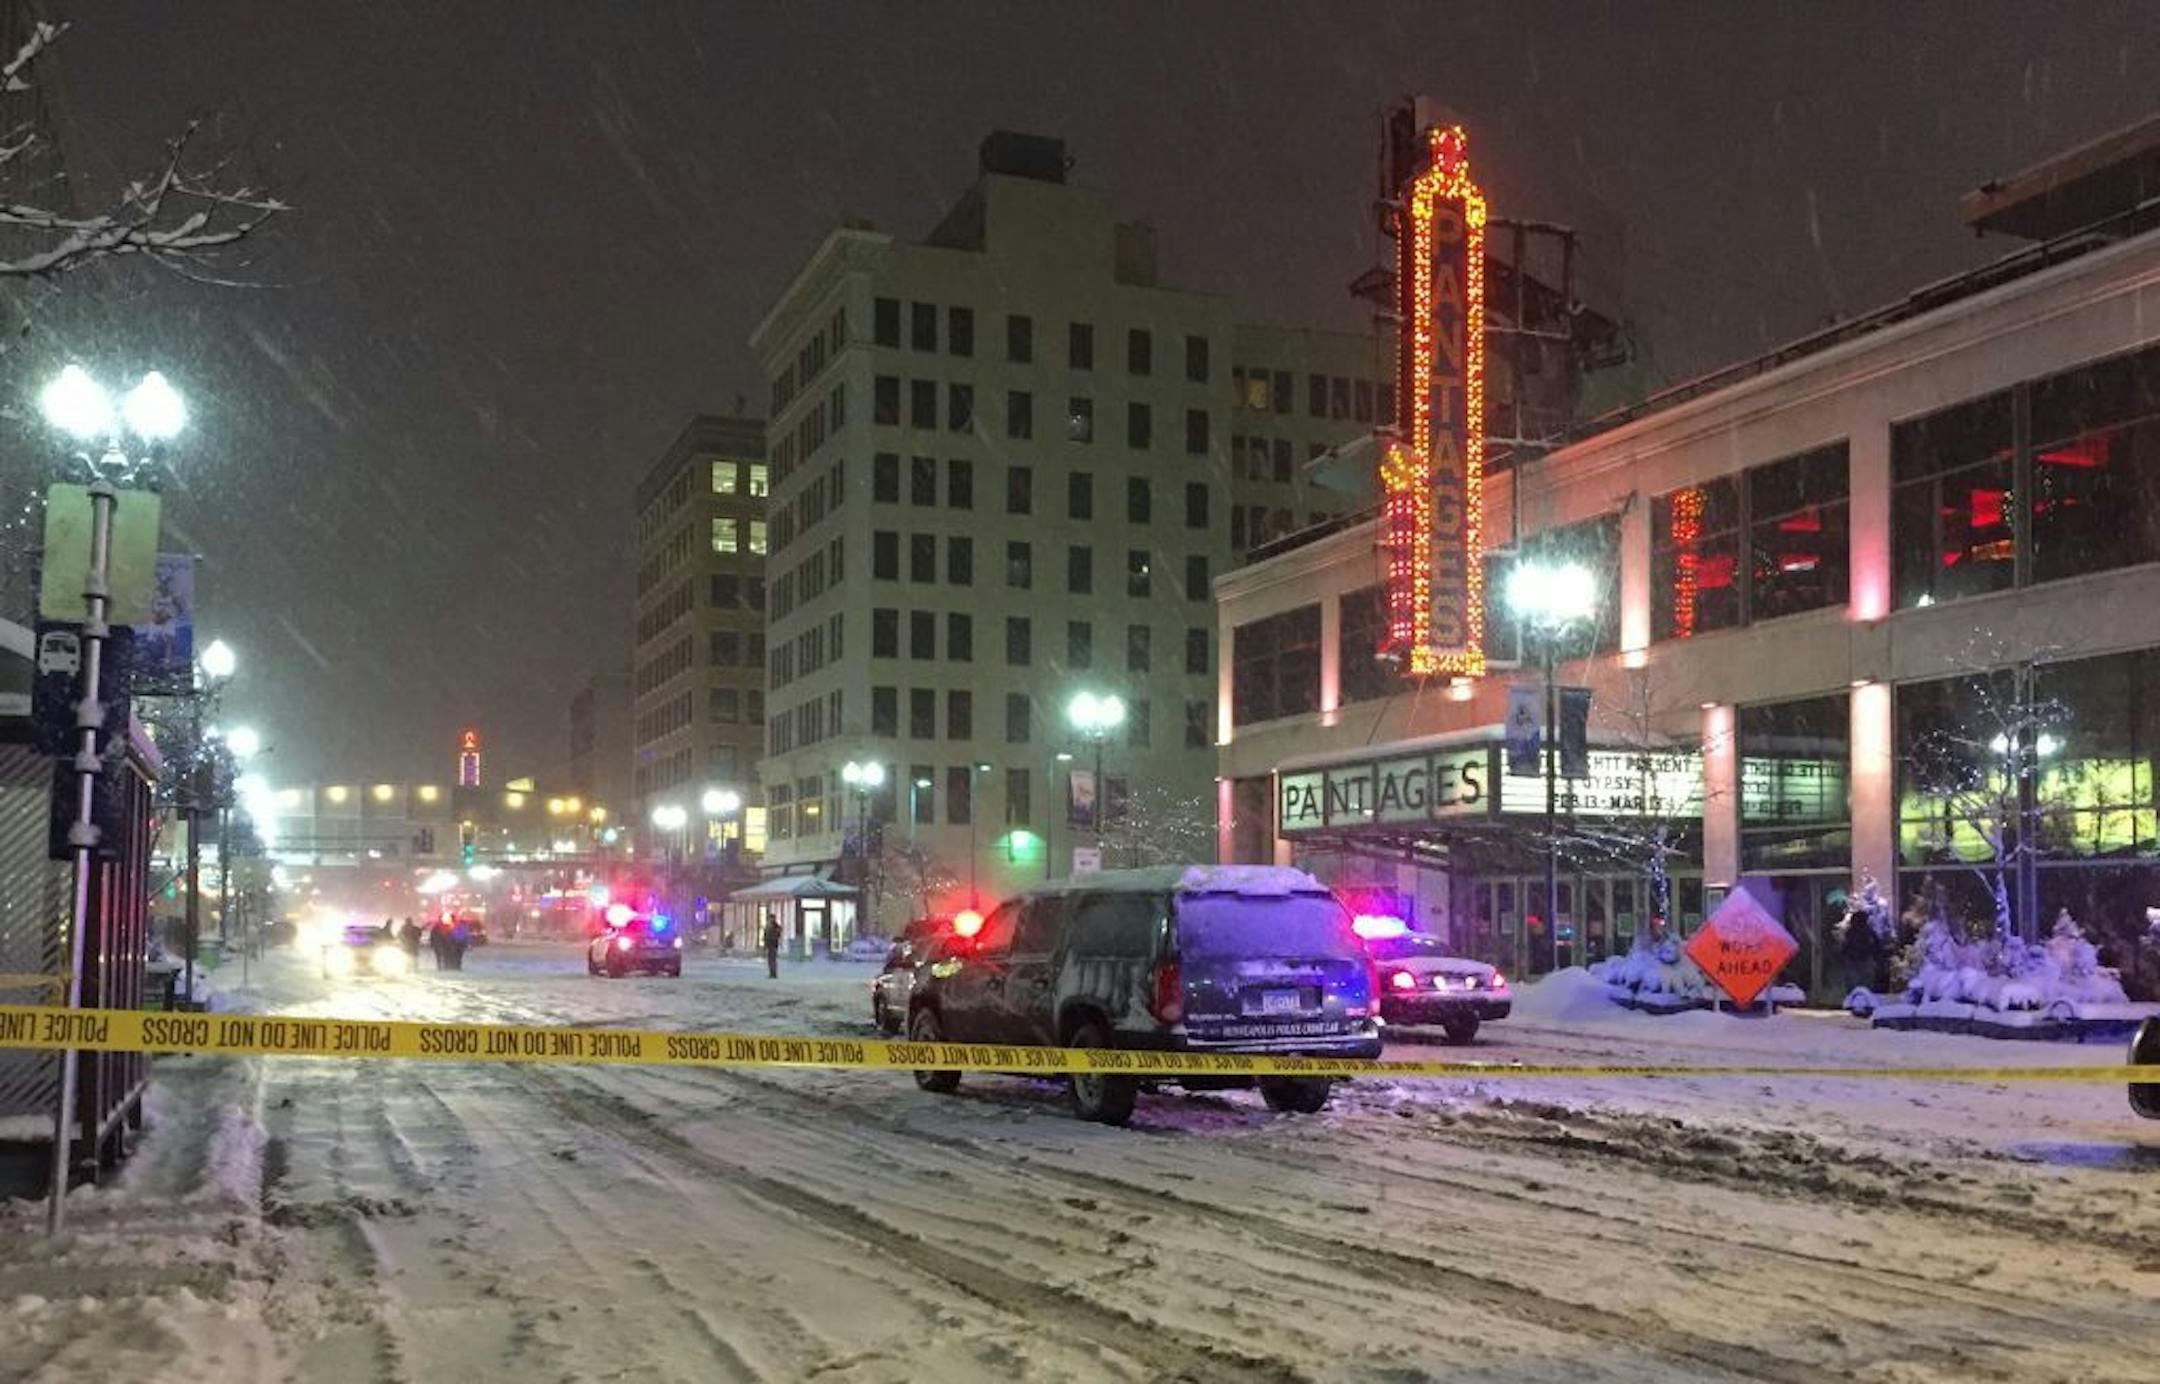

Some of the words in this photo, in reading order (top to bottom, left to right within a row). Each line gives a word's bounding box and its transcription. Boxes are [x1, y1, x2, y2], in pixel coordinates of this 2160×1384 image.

[1430, 207, 1464, 650] PANTAGES
[1286, 760, 1481, 822] PANTAGES
[1716, 959, 1772, 975] AHEAD
[43, 1014, 108, 1042] POLICE
[142, 1019, 208, 1046] CROSS
[219, 1020, 255, 1047] NOT
[261, 1022, 286, 1048] DO
[291, 1023, 327, 1049] LINE
[334, 1025, 392, 1050] POLICE
[420, 1029, 478, 1053] CROSS
[487, 1031, 519, 1054] NOT
[524, 1032, 546, 1055] DO
[552, 1033, 583, 1056] LINE
[590, 1034, 641, 1057] POLICE
[667, 1037, 720, 1058] CROSS
[726, 1038, 756, 1059] NOT
[760, 1040, 779, 1060] DO
[784, 1041, 811, 1061] LINE
[818, 1042, 864, 1062] POLICE
[888, 1044, 936, 1063] CROSS
[942, 1046, 971, 1064] NOT
[973, 1048, 991, 1064] DO
[995, 1049, 1021, 1065] LINE
[1025, 1050, 1067, 1066] POLICE
